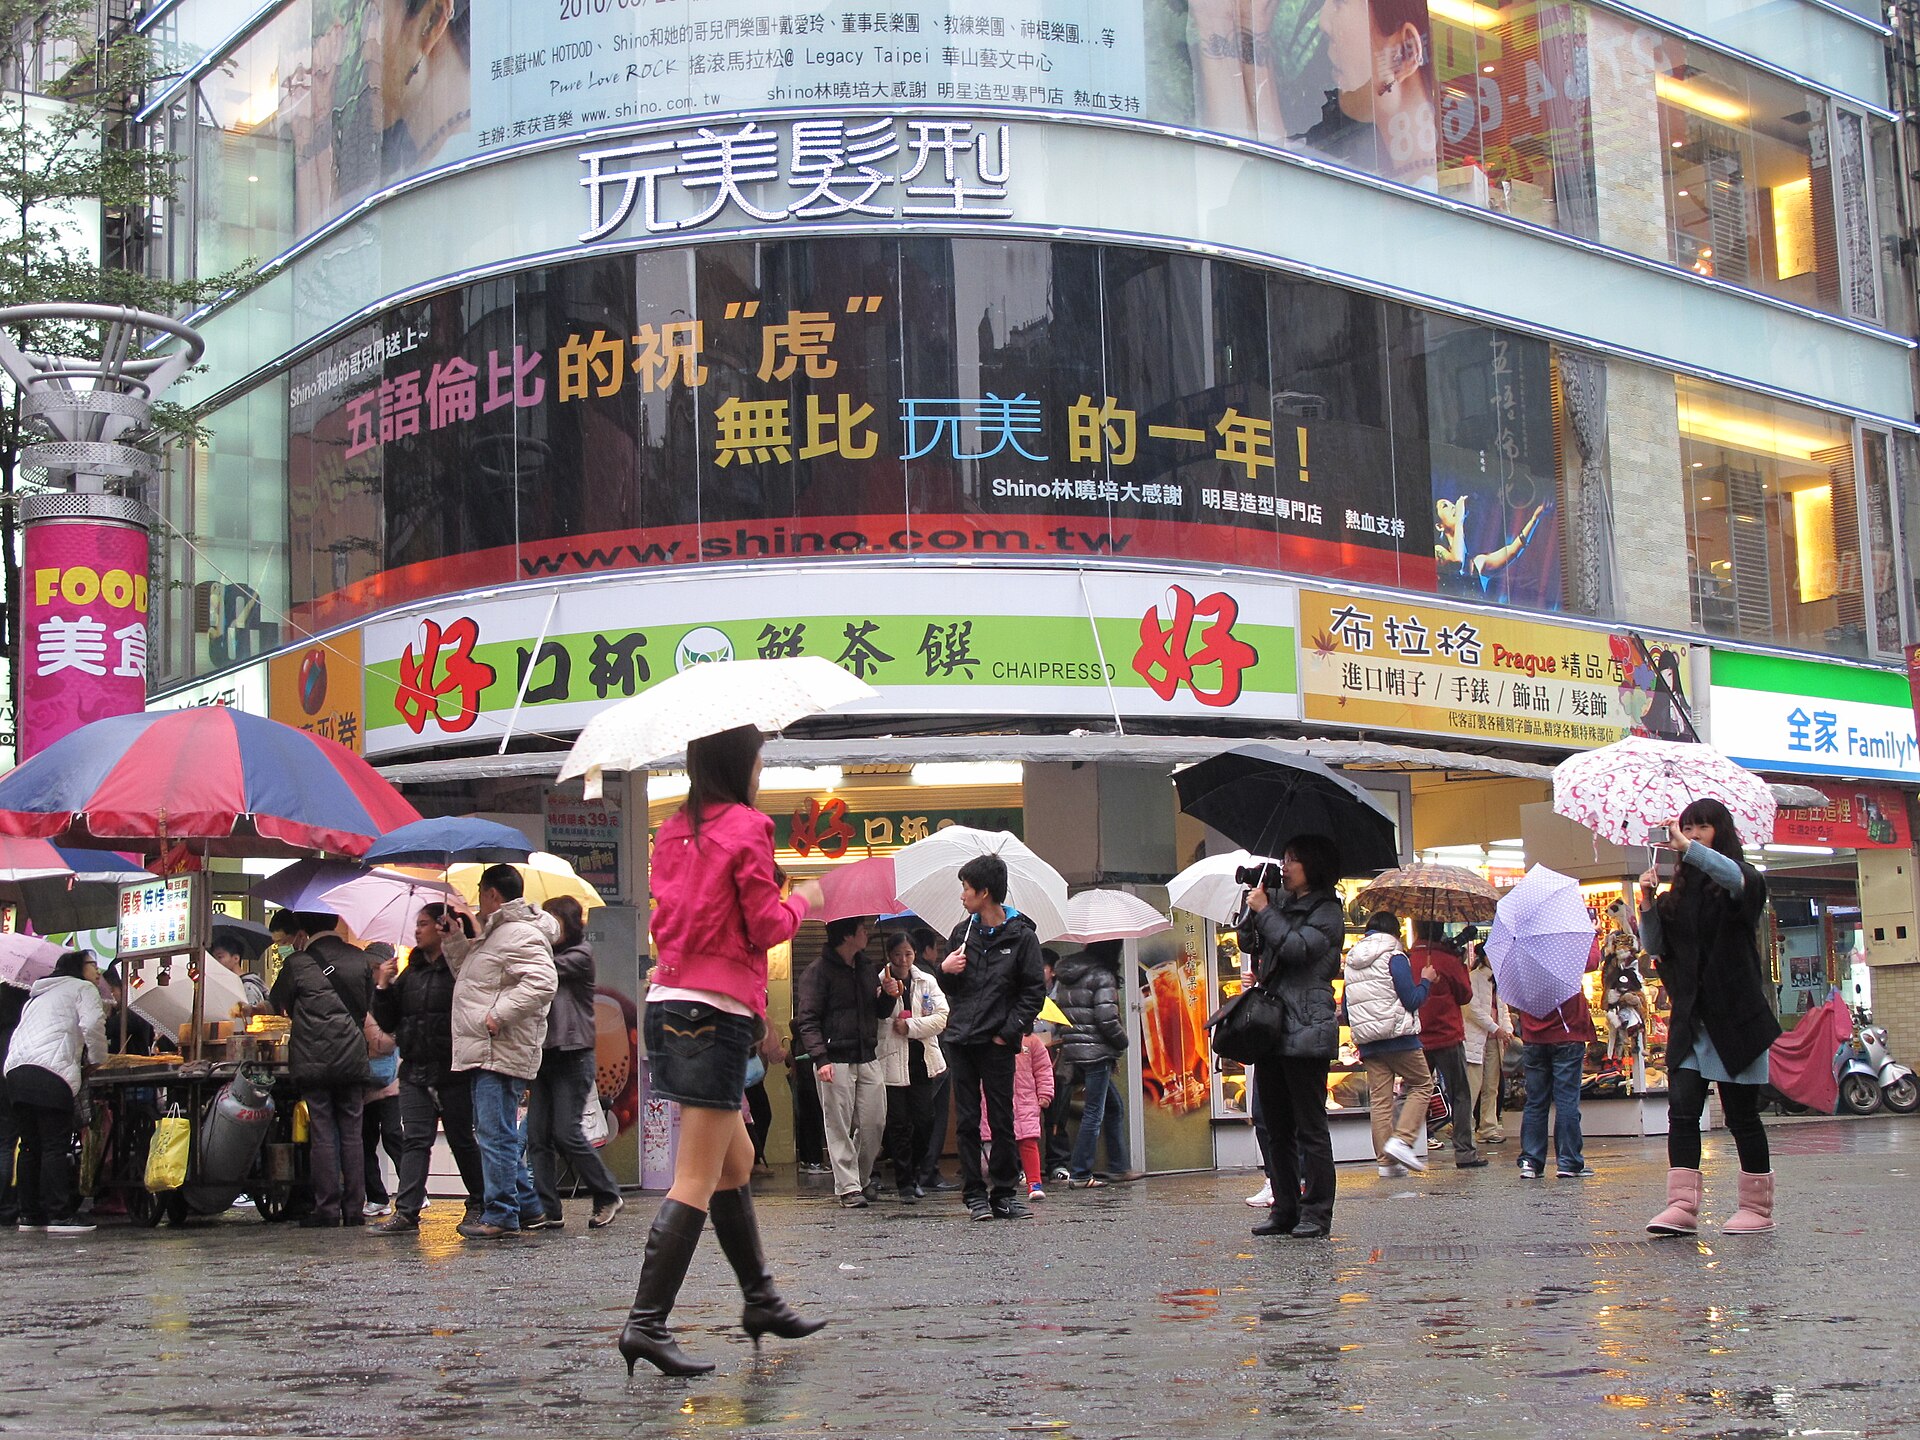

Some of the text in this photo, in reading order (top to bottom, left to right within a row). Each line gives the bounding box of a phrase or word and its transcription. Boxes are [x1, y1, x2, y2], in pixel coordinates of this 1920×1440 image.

[550, 79, 583, 97] Pure
[588, 71, 620, 90] Love
[626, 59, 679, 82] ROCK
[806, 48, 864, 67] Legacy
[874, 47, 929, 65] Taipei
[942, 46, 1053, 72] 華山藝文中心
[767, 80, 927, 101] shino林曉培大感謝
[938, 82, 1064, 105] 明星造型專門店
[1074, 89, 1140, 113] 熱血支持
[578, 116, 1014, 244] 玩美髮型
[714, 393, 879, 468] 無比
[898, 391, 1050, 462] 玩美
[992, 478, 1406, 539] Shino林曉培大感謝 明星造型專門店 熱血支持
[520, 524, 1132, 576] www.shino.com.tw
[1330, 604, 1483, 667] 布拉格
[1492, 643, 1557, 678] Prague
[992, 662, 1116, 680] CHAIPRESSO
[1787, 707, 1839, 754] 全家
